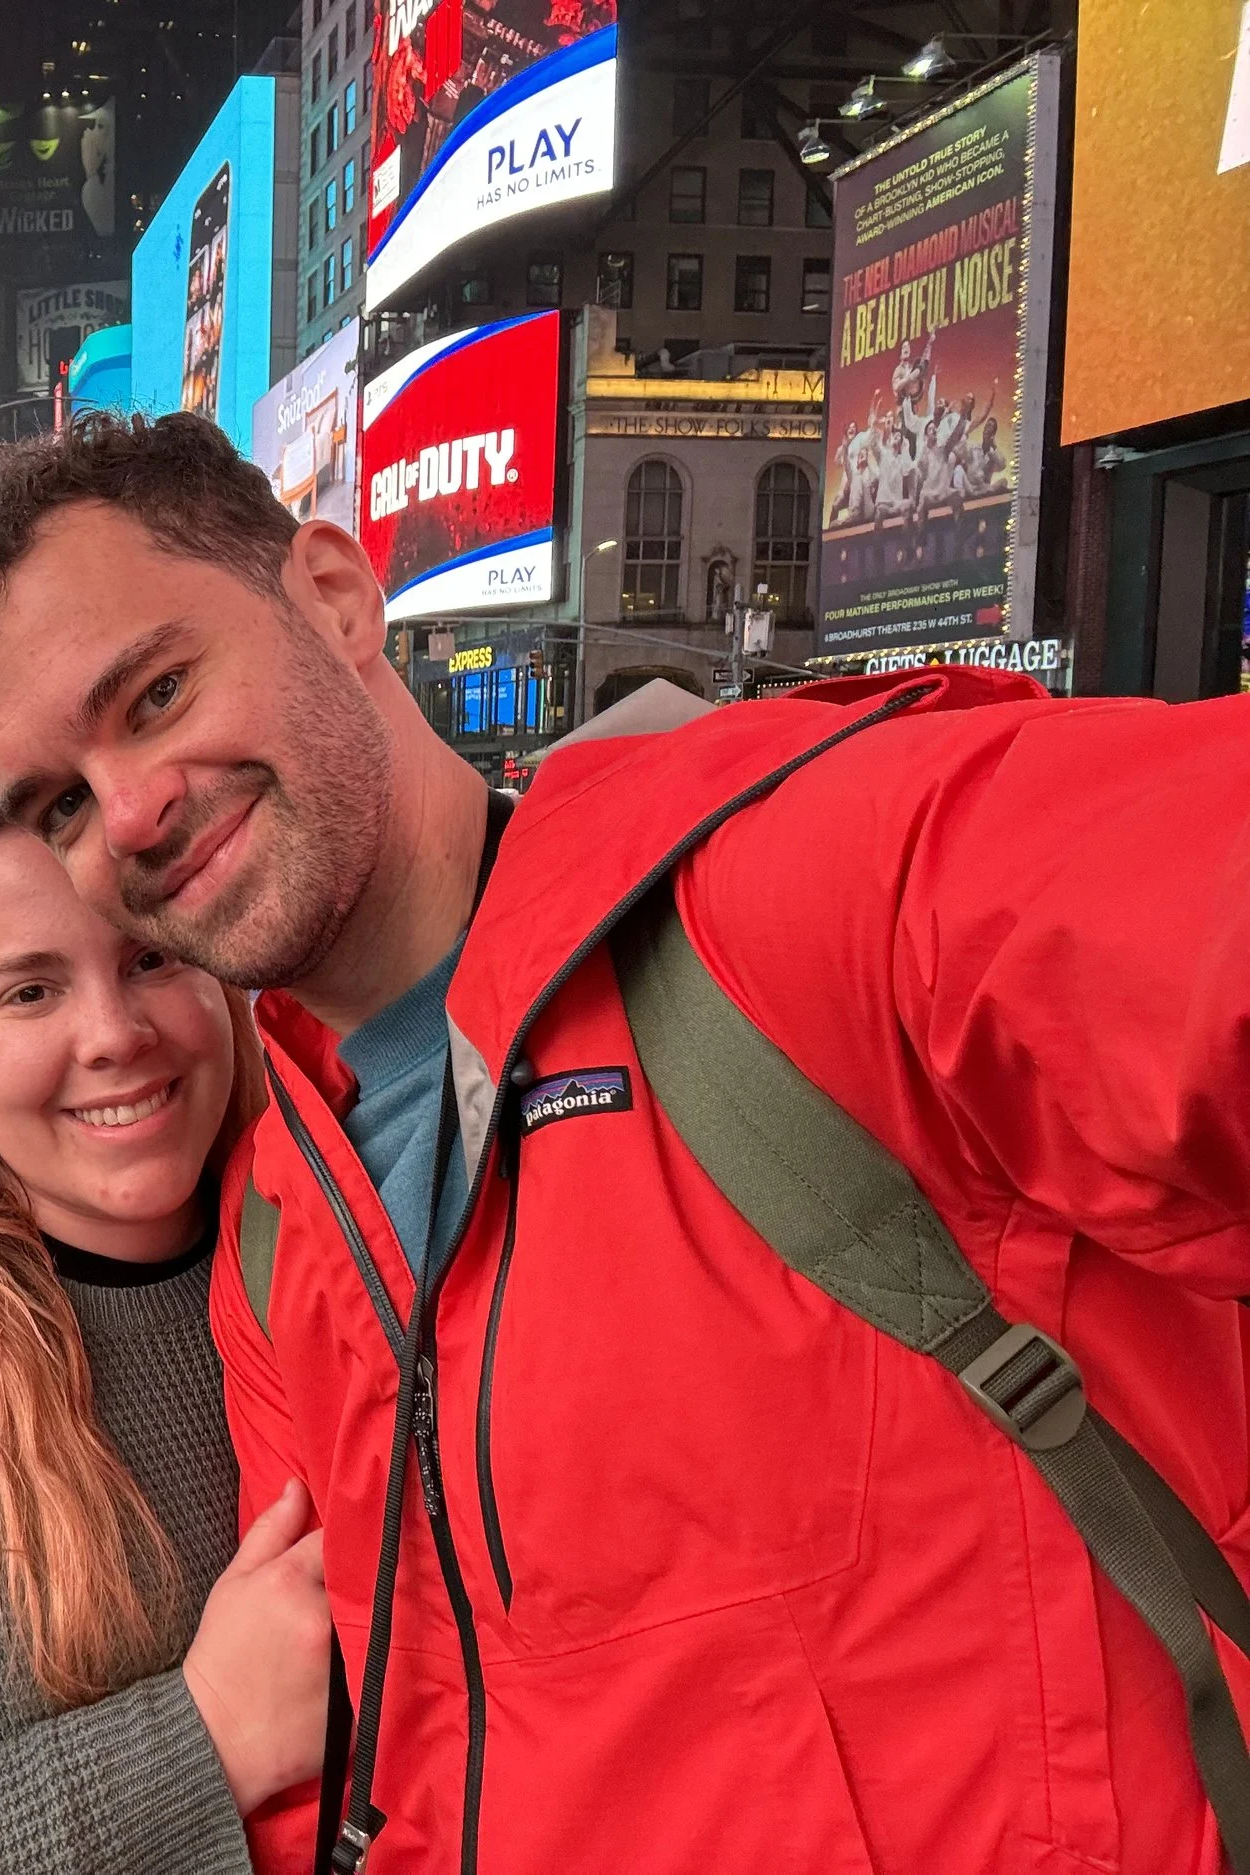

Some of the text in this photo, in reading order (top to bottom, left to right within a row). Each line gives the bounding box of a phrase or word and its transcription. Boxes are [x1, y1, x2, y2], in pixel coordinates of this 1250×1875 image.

[487, 117, 582, 184] PLAY
[874, 125, 987, 195] THE UNTOLD TRUE STORY
[476, 159, 595, 211] HAS NO LIMITS
[854, 130, 1009, 219] OF A BROOKLYN KID WHO BECAME A
[855, 163, 1004, 246] AWARD-WINNING AMERICAN ICON.
[843, 196, 1019, 305] THE NEIL DIAMOND MUSICAL
[29, 287, 82, 324] LITTLE
[841, 237, 1017, 368] A BEAUTIFUL NOISE
[613, 417, 649, 433] THE
[654, 418, 708, 435] SHOW
[371, 458, 408, 521] CALL
[488, 566, 536, 586] PLAY
[888, 585, 920, 598] BROADWAY
[921, 582, 941, 593] SHOW
[824, 609, 845, 621] FOUR
[846, 603, 880, 617] MATINEE
[881, 592, 951, 612] PERFORMANCES
[952, 589, 972, 601] PER
[828, 627, 877, 643] BROADHURST
[877, 622, 912, 636] THEATRE
[928, 617, 937, 628] W
[938, 614, 960, 627] 44TH
[449, 646, 492, 673] EXPRESS
[944, 638, 1059, 673] LUGGAGE
[525, 1090, 612, 1127] patagonia
